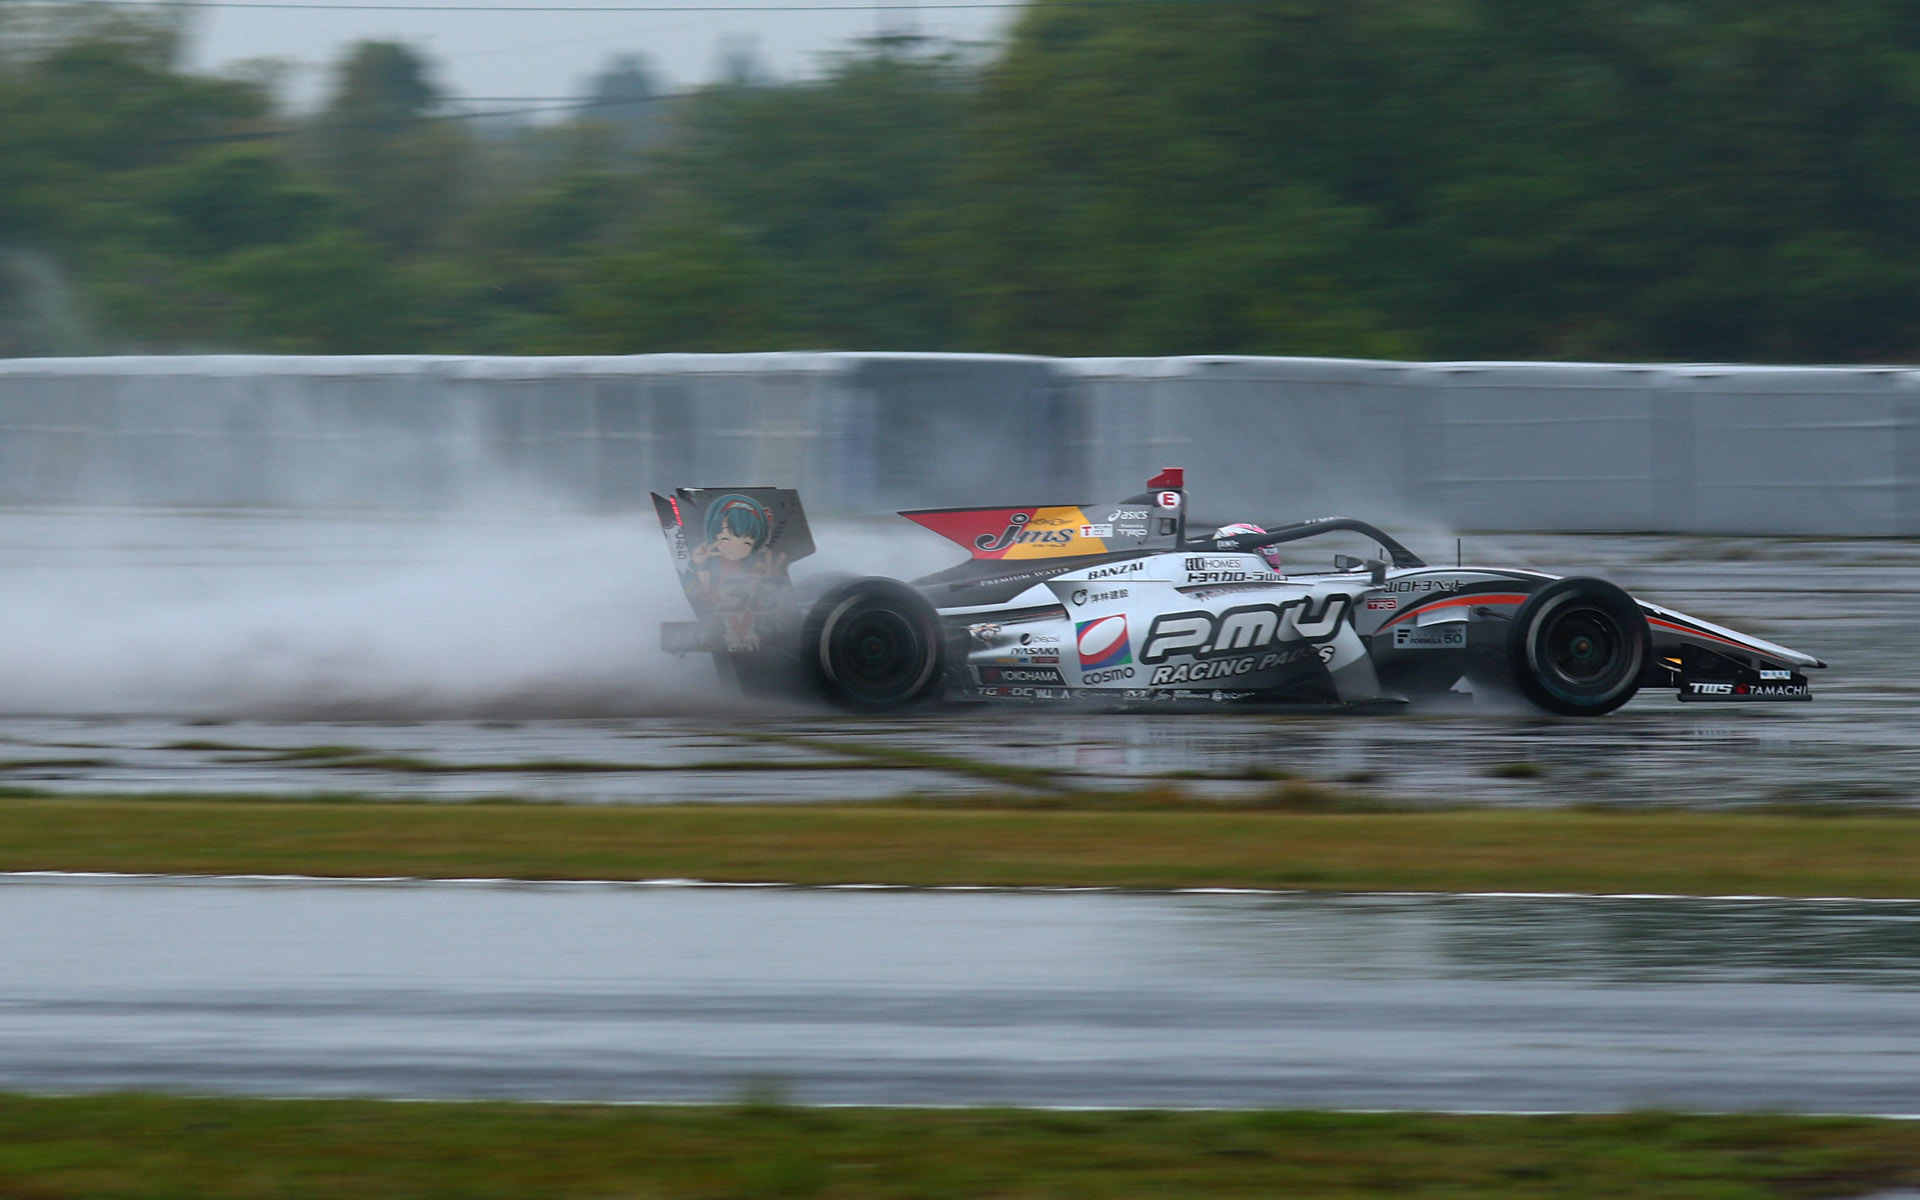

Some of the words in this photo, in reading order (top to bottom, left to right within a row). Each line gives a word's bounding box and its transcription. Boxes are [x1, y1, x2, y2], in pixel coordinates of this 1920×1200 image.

[1163, 494, 1175, 506] E
[1120, 510, 1148, 520] asics
[1206, 559, 1240, 569] HOMES
[980, 573, 1031, 586] PREMIUM
[1034, 567, 1071, 578] WATER
[1088, 562, 1144, 580] BANZAI
[1444, 633, 1463, 644] 50
[1001, 671, 1059, 681] YOKOHAMA
[1149, 656, 1256, 686] RACING
[1689, 683, 1733, 695] TWS
[1749, 685, 1807, 695] TAMACHI
